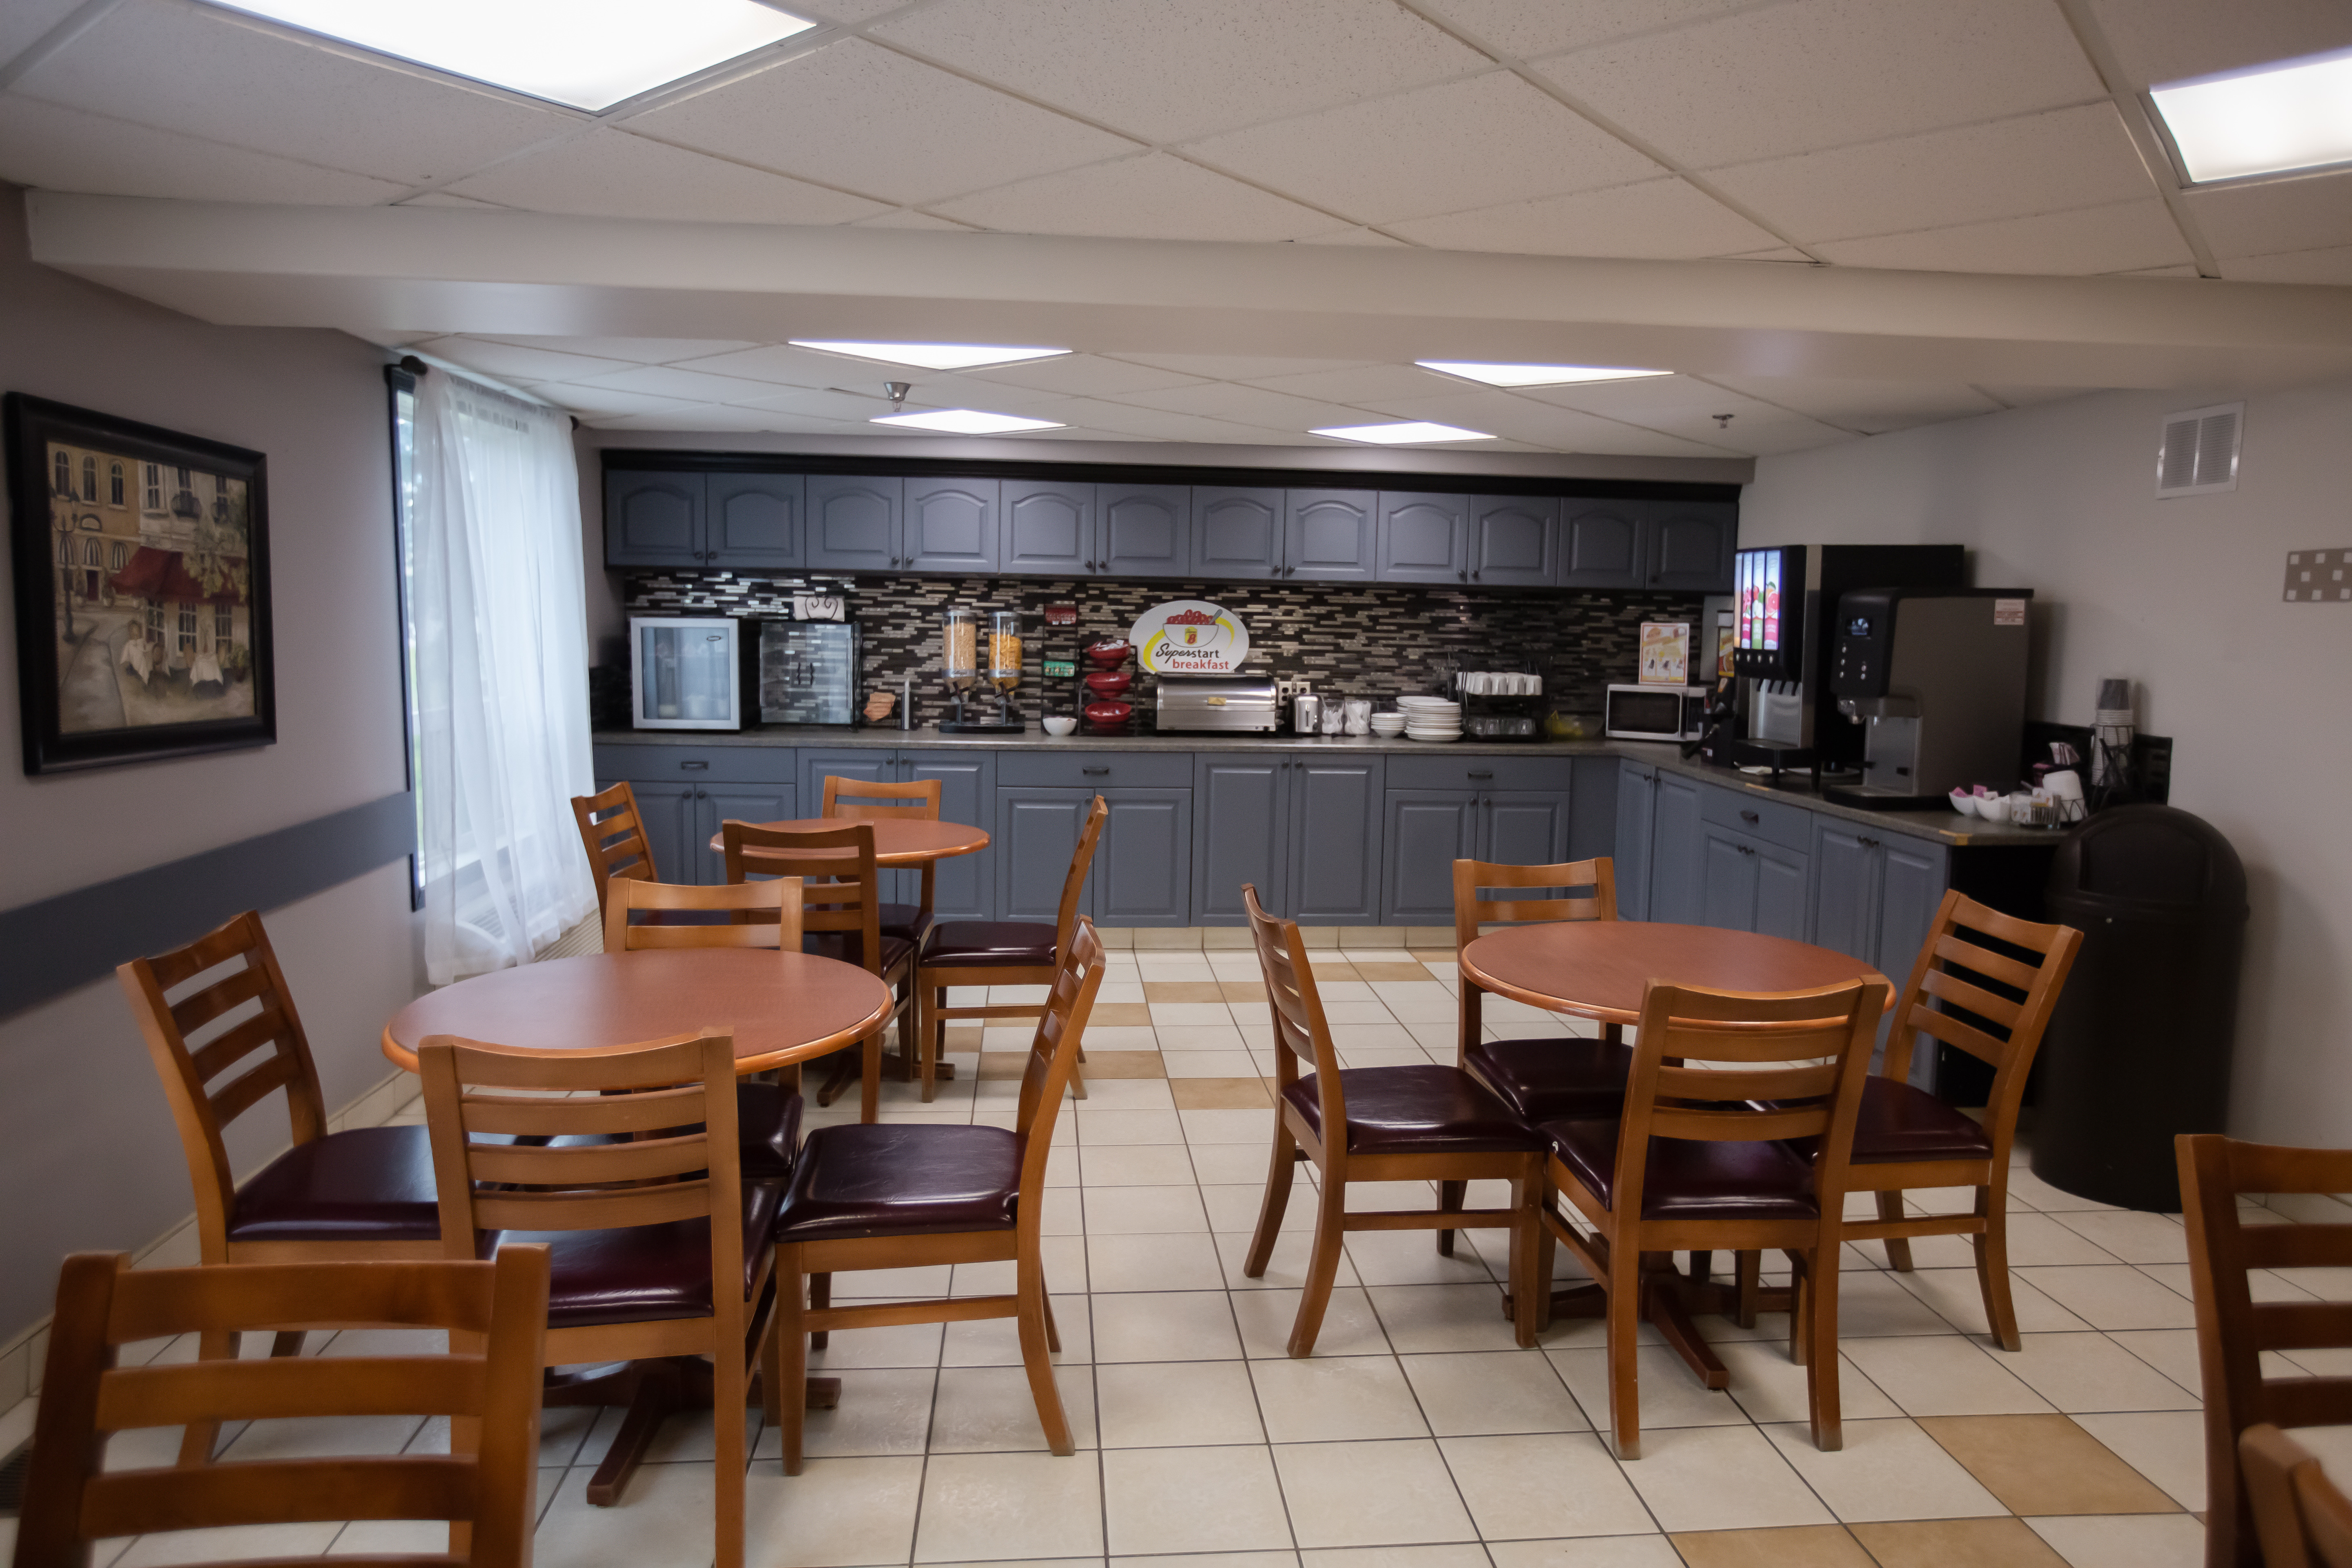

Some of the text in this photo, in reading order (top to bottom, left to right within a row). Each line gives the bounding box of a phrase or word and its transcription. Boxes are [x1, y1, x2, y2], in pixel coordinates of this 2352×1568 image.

[1187, 633, 1196, 644] 8
[1156, 643, 1219, 664] Superstart
[1173, 659, 1229, 669] breakfast
